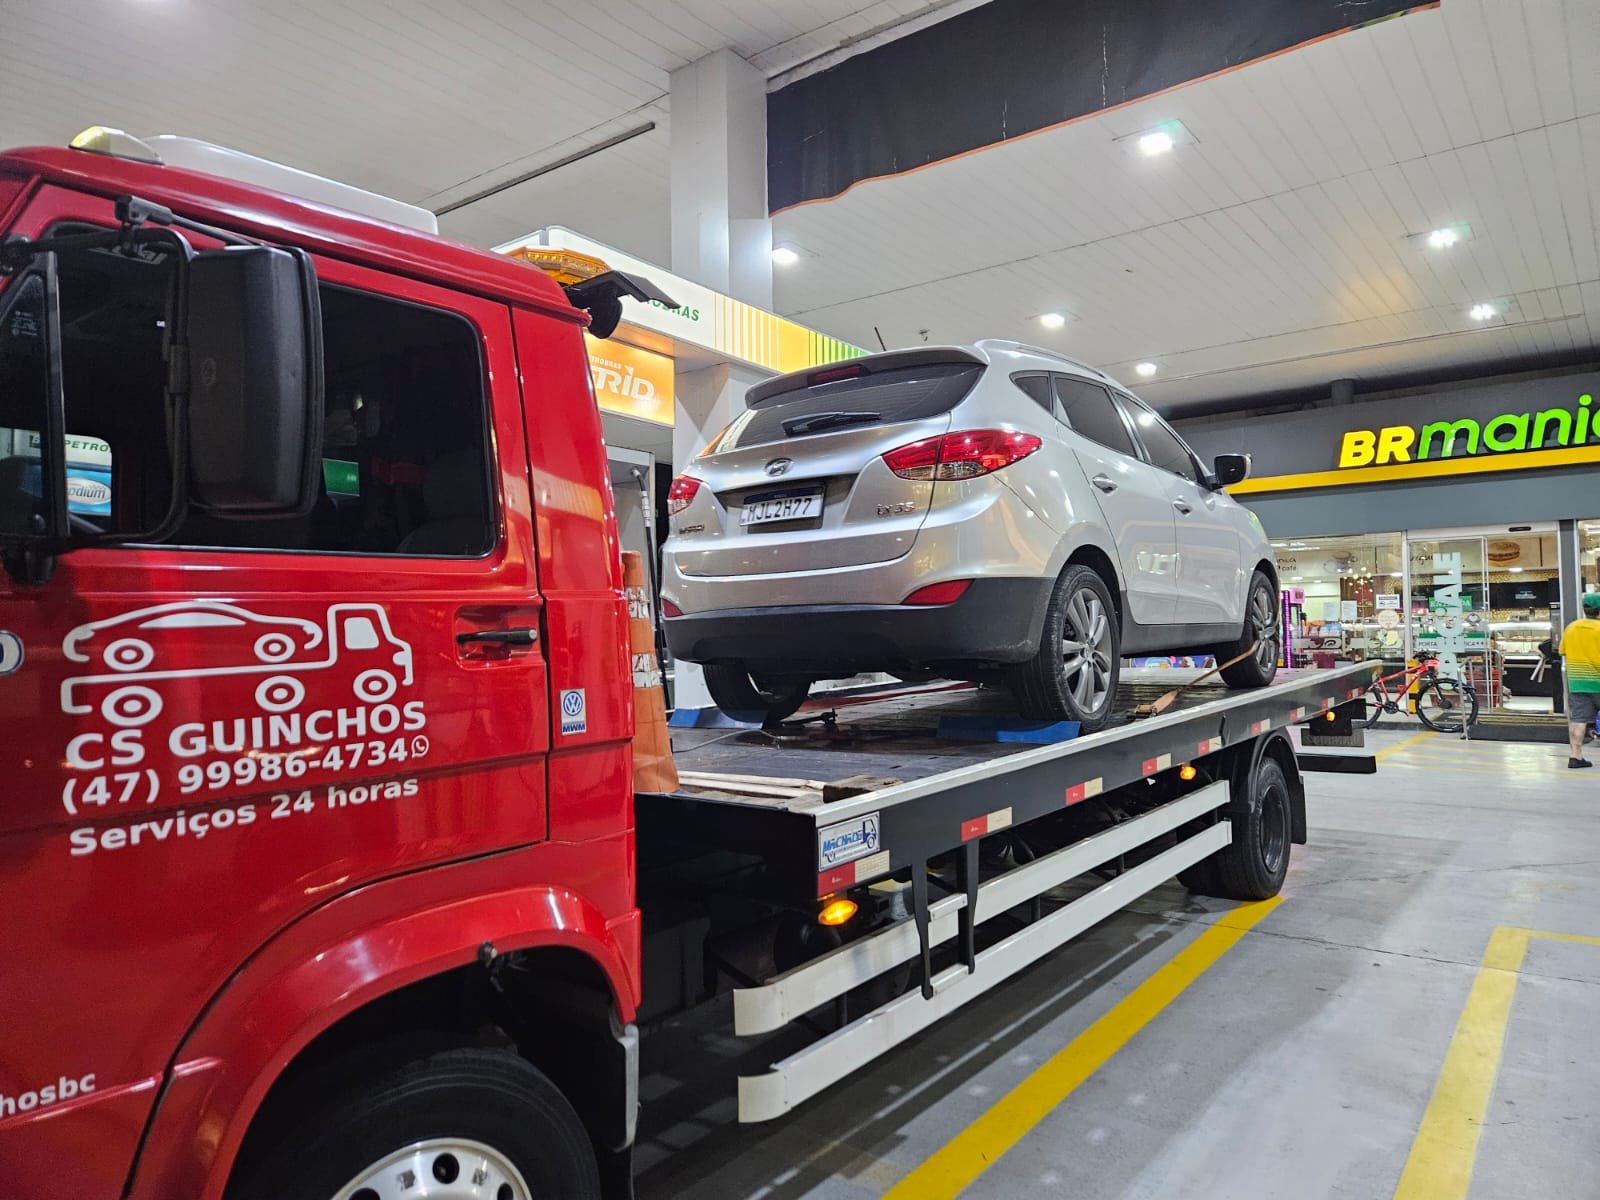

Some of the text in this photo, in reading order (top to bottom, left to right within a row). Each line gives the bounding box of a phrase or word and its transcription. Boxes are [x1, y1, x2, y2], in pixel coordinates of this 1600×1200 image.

[64, 440, 110, 452] PETRO
[1339, 393, 1600, 468] BRmani
[67, 485, 106, 499] odium
[65, 700, 427, 770] CS GUINCHOS
[562, 724, 585, 733] MWM
[62, 737, 409, 815] (47) 99986-4734
[69, 777, 419, 856] Serviços 24 horas
